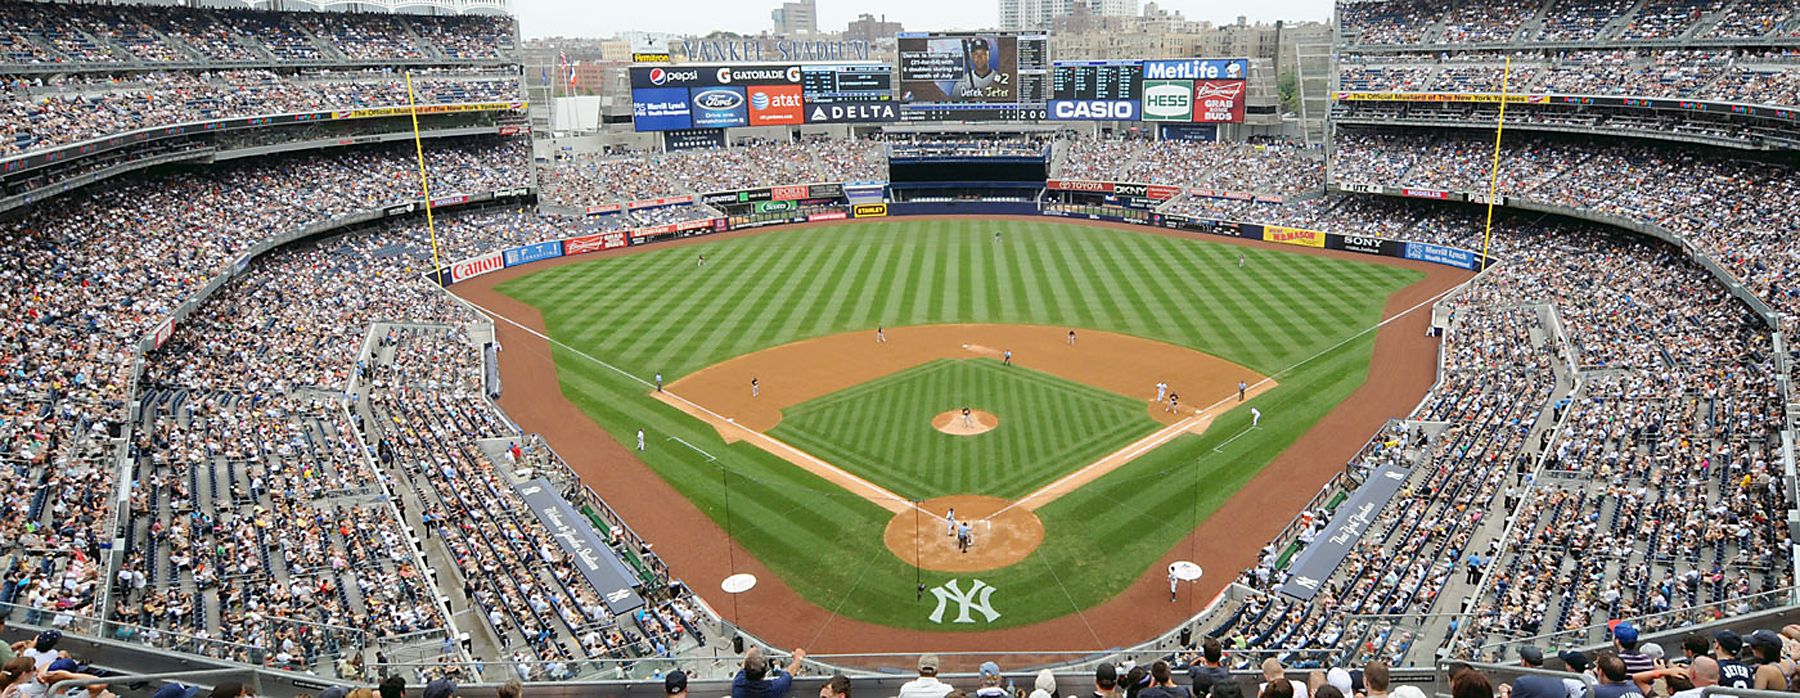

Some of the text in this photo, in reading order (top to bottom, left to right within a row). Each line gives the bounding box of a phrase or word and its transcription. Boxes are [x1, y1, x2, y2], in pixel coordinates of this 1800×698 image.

[733, 70, 784, 80] GATORADE
[1147, 60, 1219, 79] MetLife
[667, 70, 698, 82] pepsi
[994, 73, 1010, 85] #2
[961, 87, 1009, 97] Derek Jeter
[647, 102, 668, 110] Merrill
[668, 101, 686, 111] Lynch
[705, 94, 733, 107] Ford
[771, 93, 801, 107] at&t
[1147, 95, 1188, 107] HESS
[1204, 100, 1234, 108] GRAB
[832, 105, 895, 119] DELTA
[1056, 101, 1133, 118] CASIO
[1204, 112, 1233, 120] BUDS
[1072, 182, 1104, 190] TOYOTA
[1115, 185, 1148, 195] DKNY
[1353, 184, 1369, 192] UTZ
[857, 206, 883, 214] STANLEY
[1344, 235, 1383, 248] SONY
[453, 255, 503, 280] Canon
[1723, 664, 1749, 679] JETER
